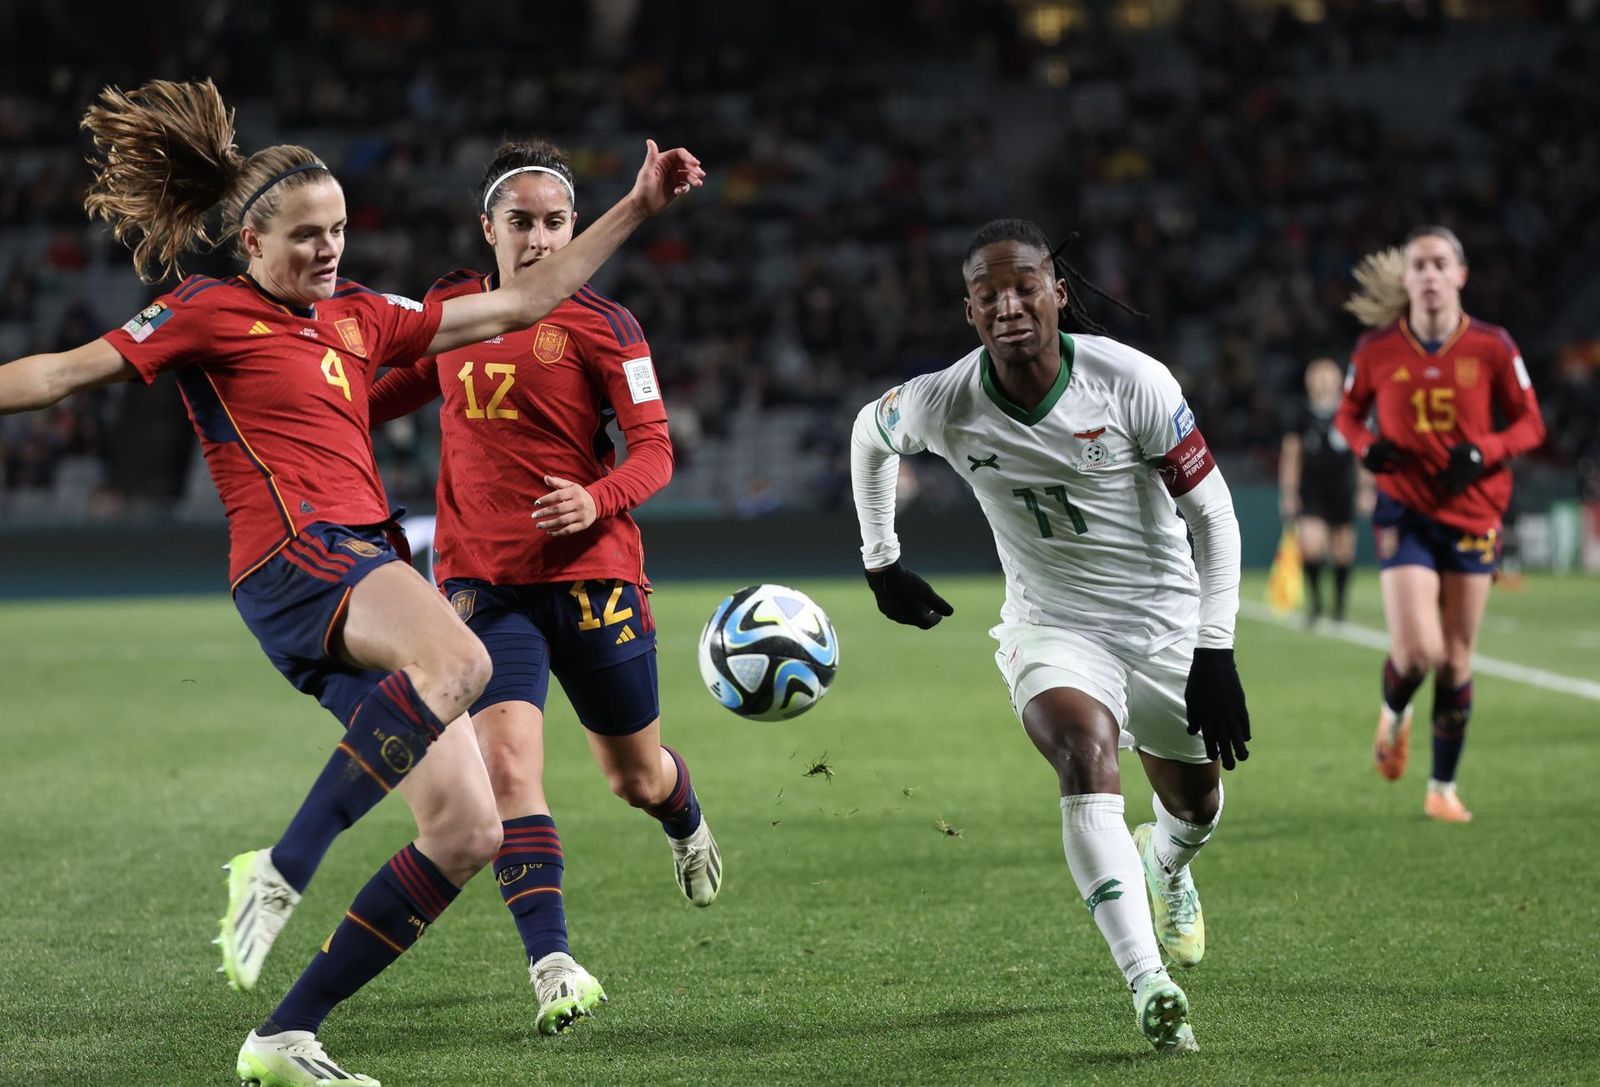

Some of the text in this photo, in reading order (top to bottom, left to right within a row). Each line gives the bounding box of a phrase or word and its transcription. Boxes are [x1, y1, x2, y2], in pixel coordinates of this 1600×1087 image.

[320, 347, 352, 402] 4
[457, 361, 519, 420] 12
[1410, 386, 1456, 433] 15
[1185, 458, 1205, 478] PEOPLES
[1012, 484, 1089, 538] 11
[568, 578, 634, 632] 12
